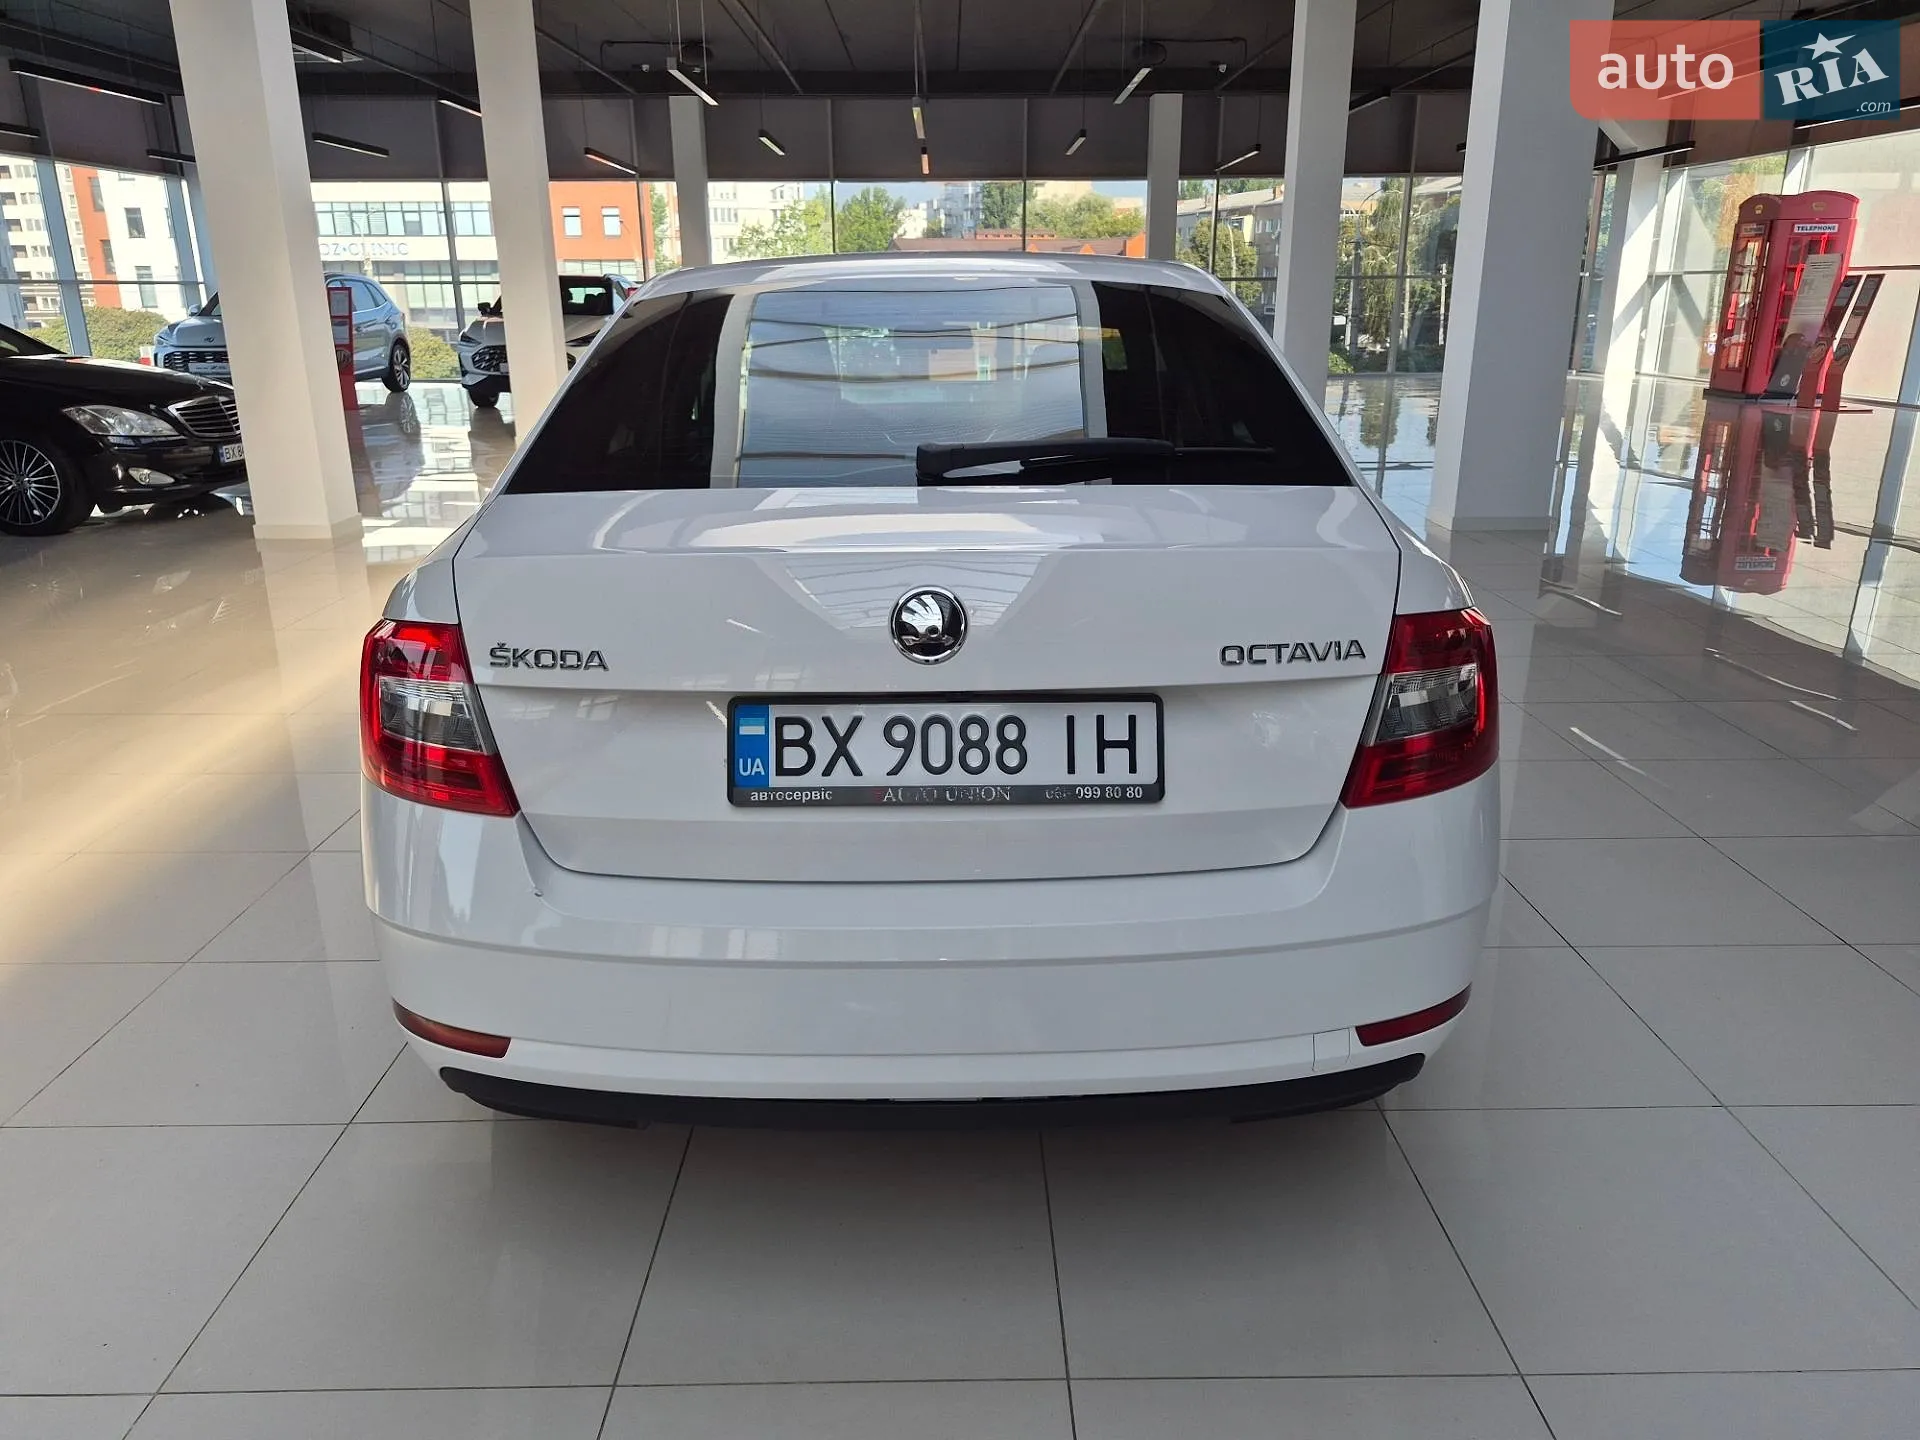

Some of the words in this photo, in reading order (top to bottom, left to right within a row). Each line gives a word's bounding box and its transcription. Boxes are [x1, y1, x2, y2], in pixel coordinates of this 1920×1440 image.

[490, 641, 609, 672] ŠKODA
[1219, 639, 1366, 666] OCTAVIA
[774, 715, 863, 777] BX
[883, 714, 1028, 776] 9088
[1066, 714, 1137, 774] IH
[738, 758, 765, 776] UA
[750, 787, 833, 804] автосервіс
[1075, 786, 1101, 799] 099
[1105, 786, 1122, 799] 80
[1126, 786, 1143, 799] 80
